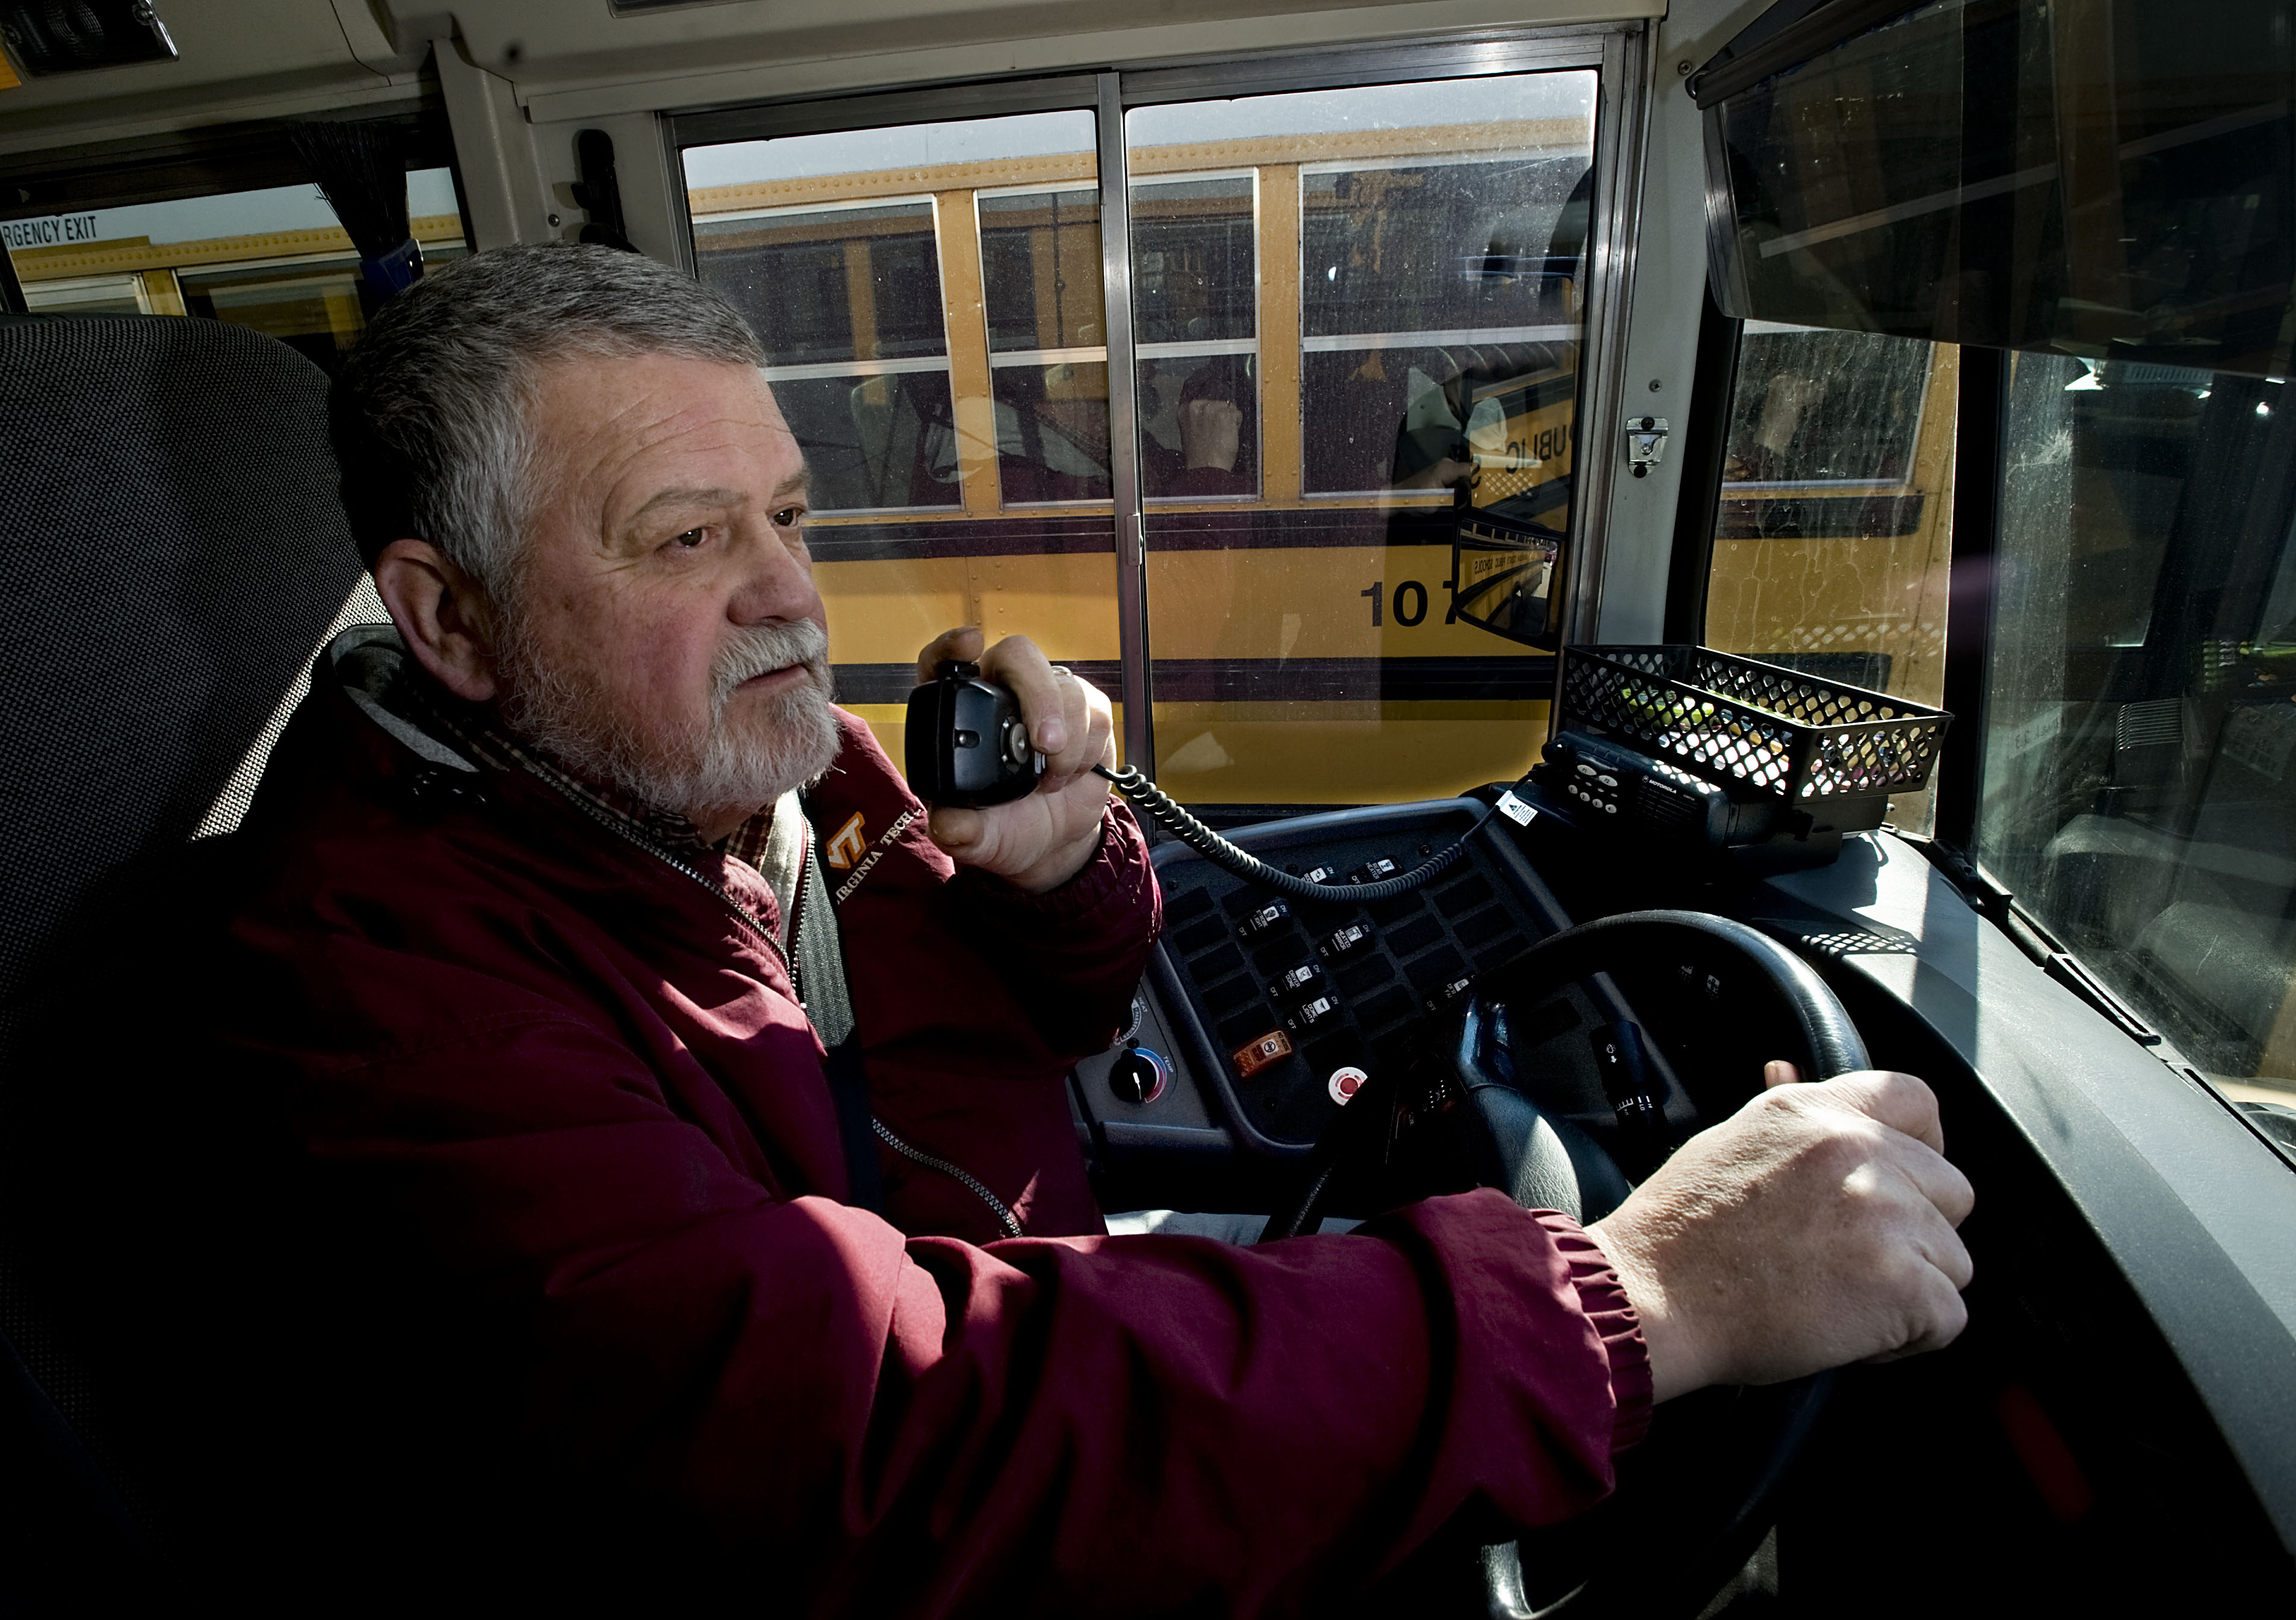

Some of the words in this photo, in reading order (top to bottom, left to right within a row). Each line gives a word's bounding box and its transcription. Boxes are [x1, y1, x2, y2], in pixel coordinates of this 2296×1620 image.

[2, 220, 60, 247] RGENCY
[64, 215, 97, 241] EXIT
[1649, 779, 1677, 794] MOTOROLA
[836, 850, 883, 904] IRGINIA
[880, 811, 915, 846] TECH
[1365, 861, 1380, 880] HEATER
[1372, 862, 1383, 875] REAR
[1338, 929, 1351, 948] HEATED
[1313, 964, 1321, 973] ON
[1285, 974, 1295, 989] DOME
[1289, 969, 1301, 988] DRIVER
[1138, 997, 1148, 1012] HEAT
[1331, 996, 1339, 1005] ON
[1302, 1004, 1315, 1024] LIGHTS
[1307, 1003, 1318, 1018] DOME
[1163, 1055, 1174, 1073] TEMP
